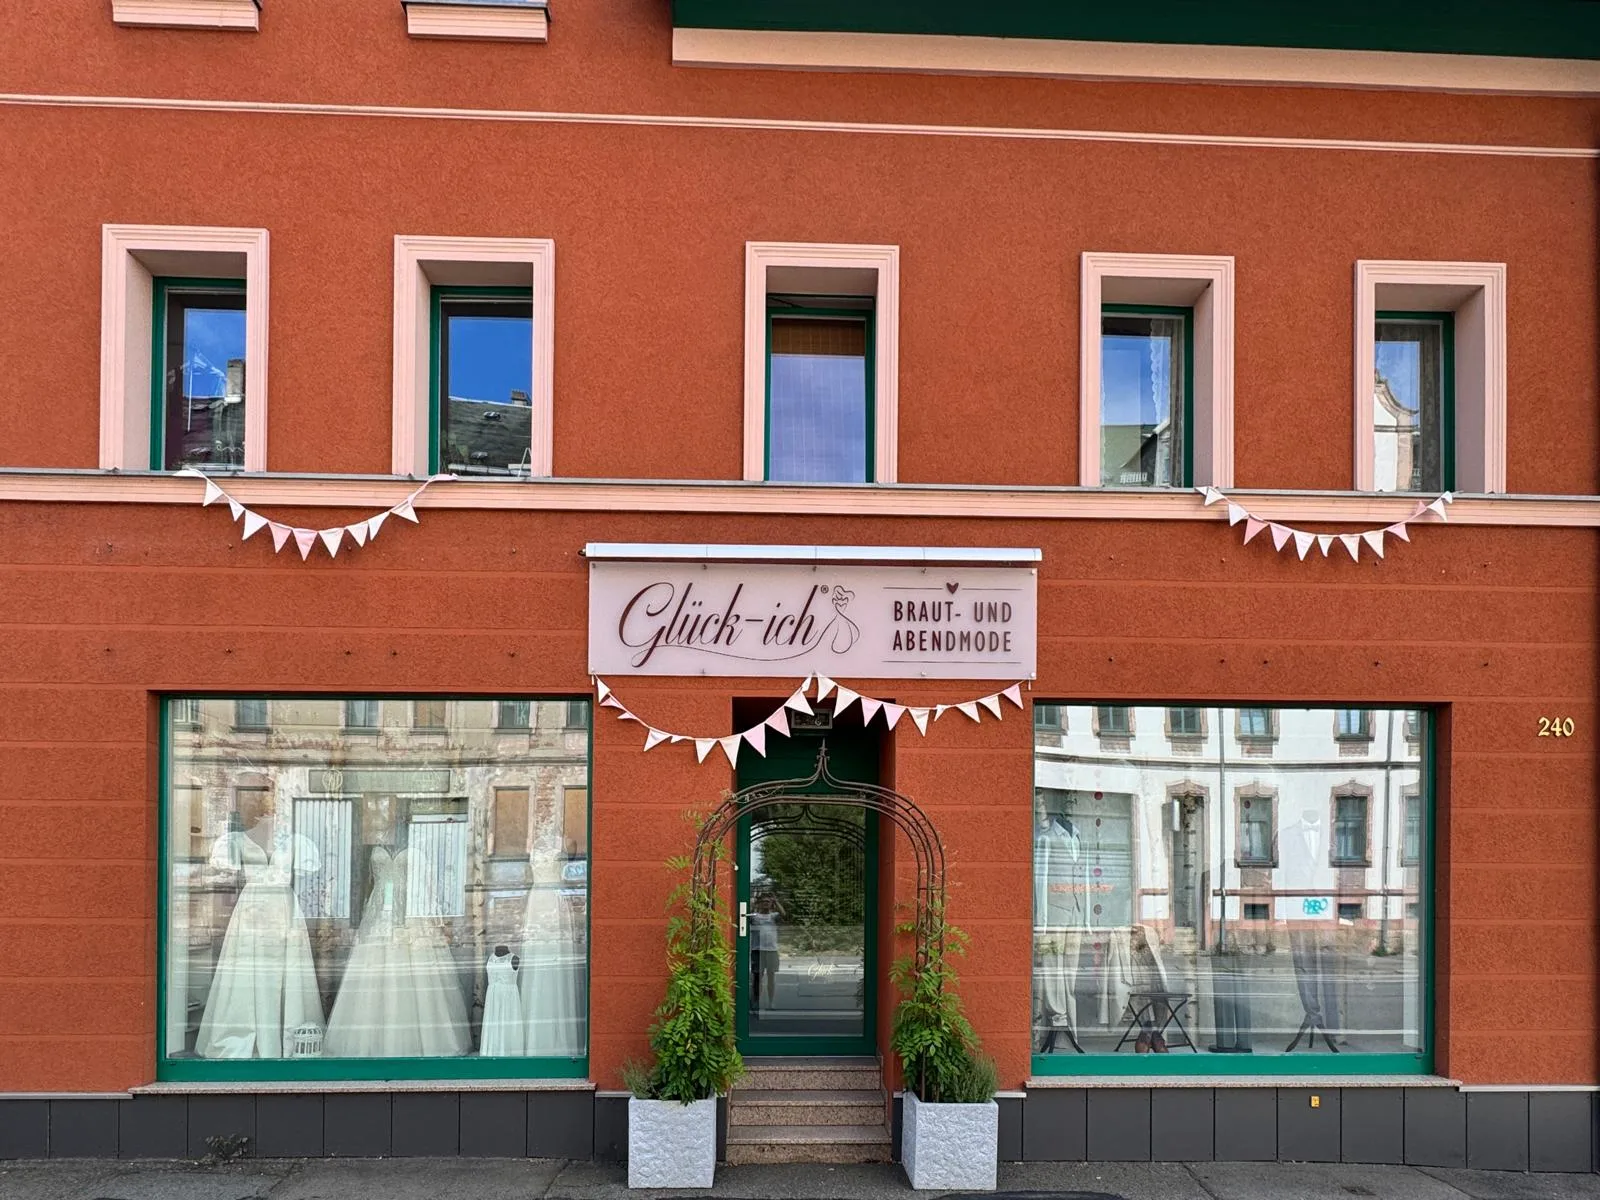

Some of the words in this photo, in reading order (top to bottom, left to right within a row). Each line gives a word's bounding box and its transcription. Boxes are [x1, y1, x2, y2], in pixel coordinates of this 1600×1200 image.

[893, 600, 962, 622] BRAUT-
[973, 601, 1012, 623] UND
[892, 629, 1012, 652] ABENDMODE
[1538, 716, 1575, 737] 240
